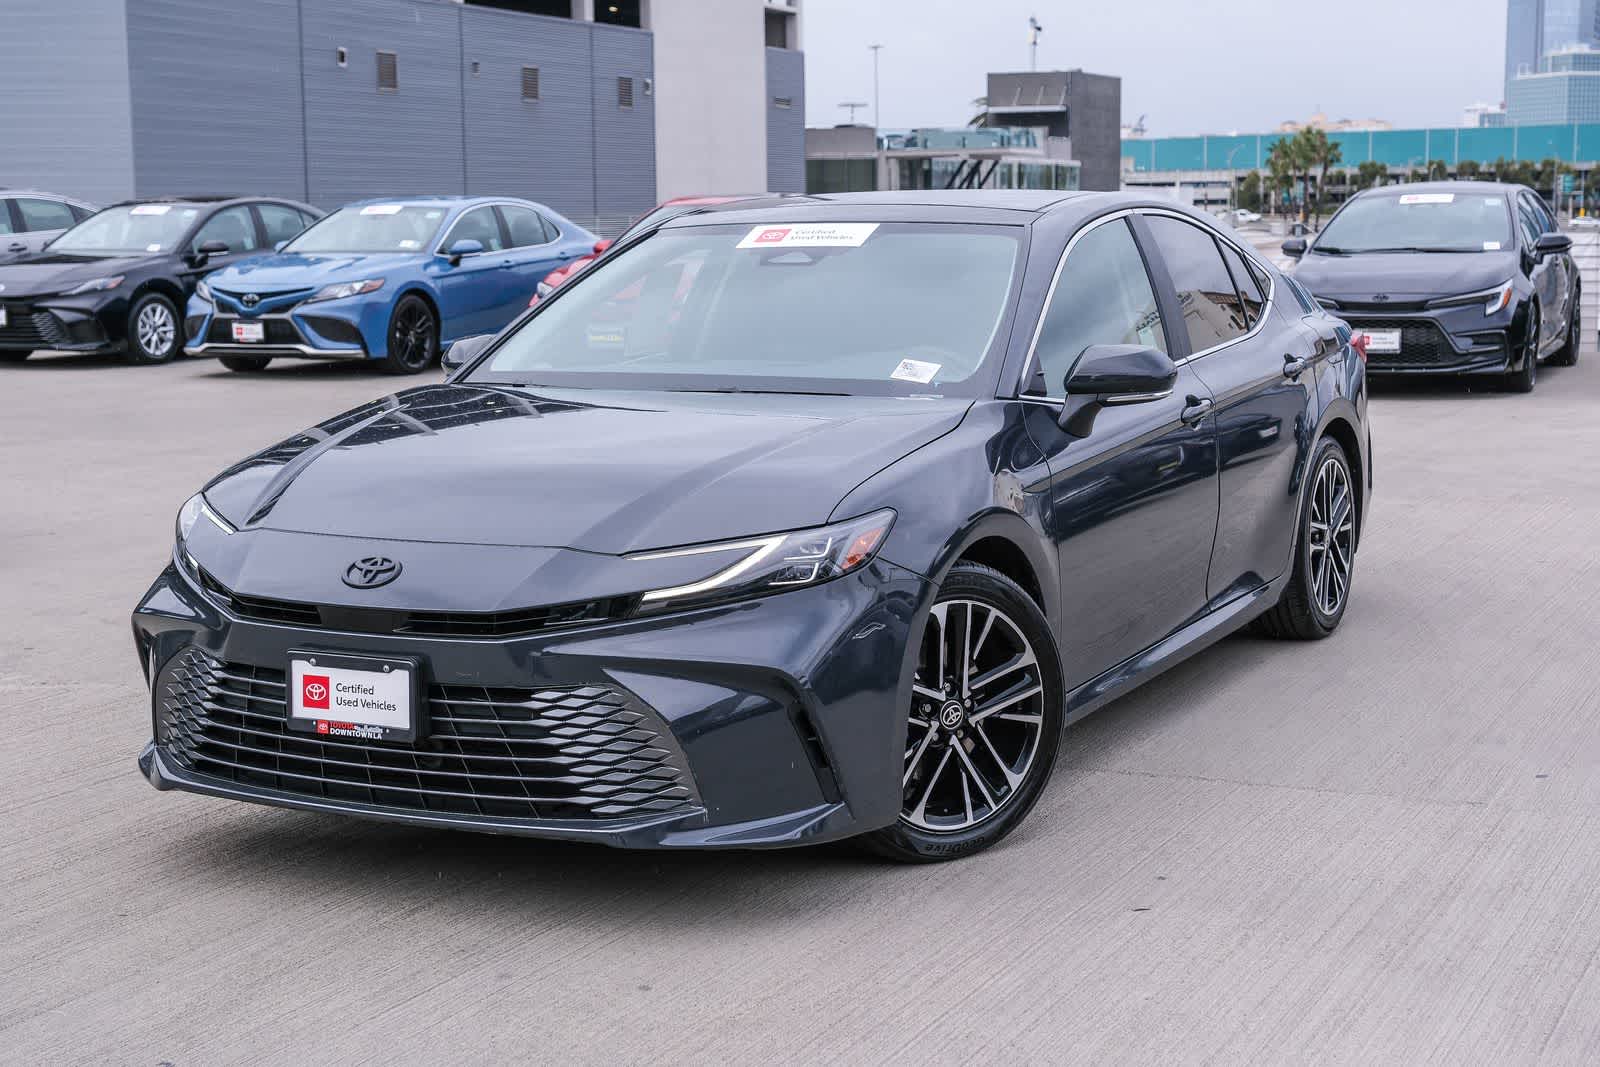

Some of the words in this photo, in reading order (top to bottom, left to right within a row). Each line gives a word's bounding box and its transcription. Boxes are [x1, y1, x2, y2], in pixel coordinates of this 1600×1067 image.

[336, 683, 375, 695] Certified
[336, 697, 358, 707] Used
[360, 699, 397, 711] Vehicles
[330, 721, 354, 730] TOYOTA
